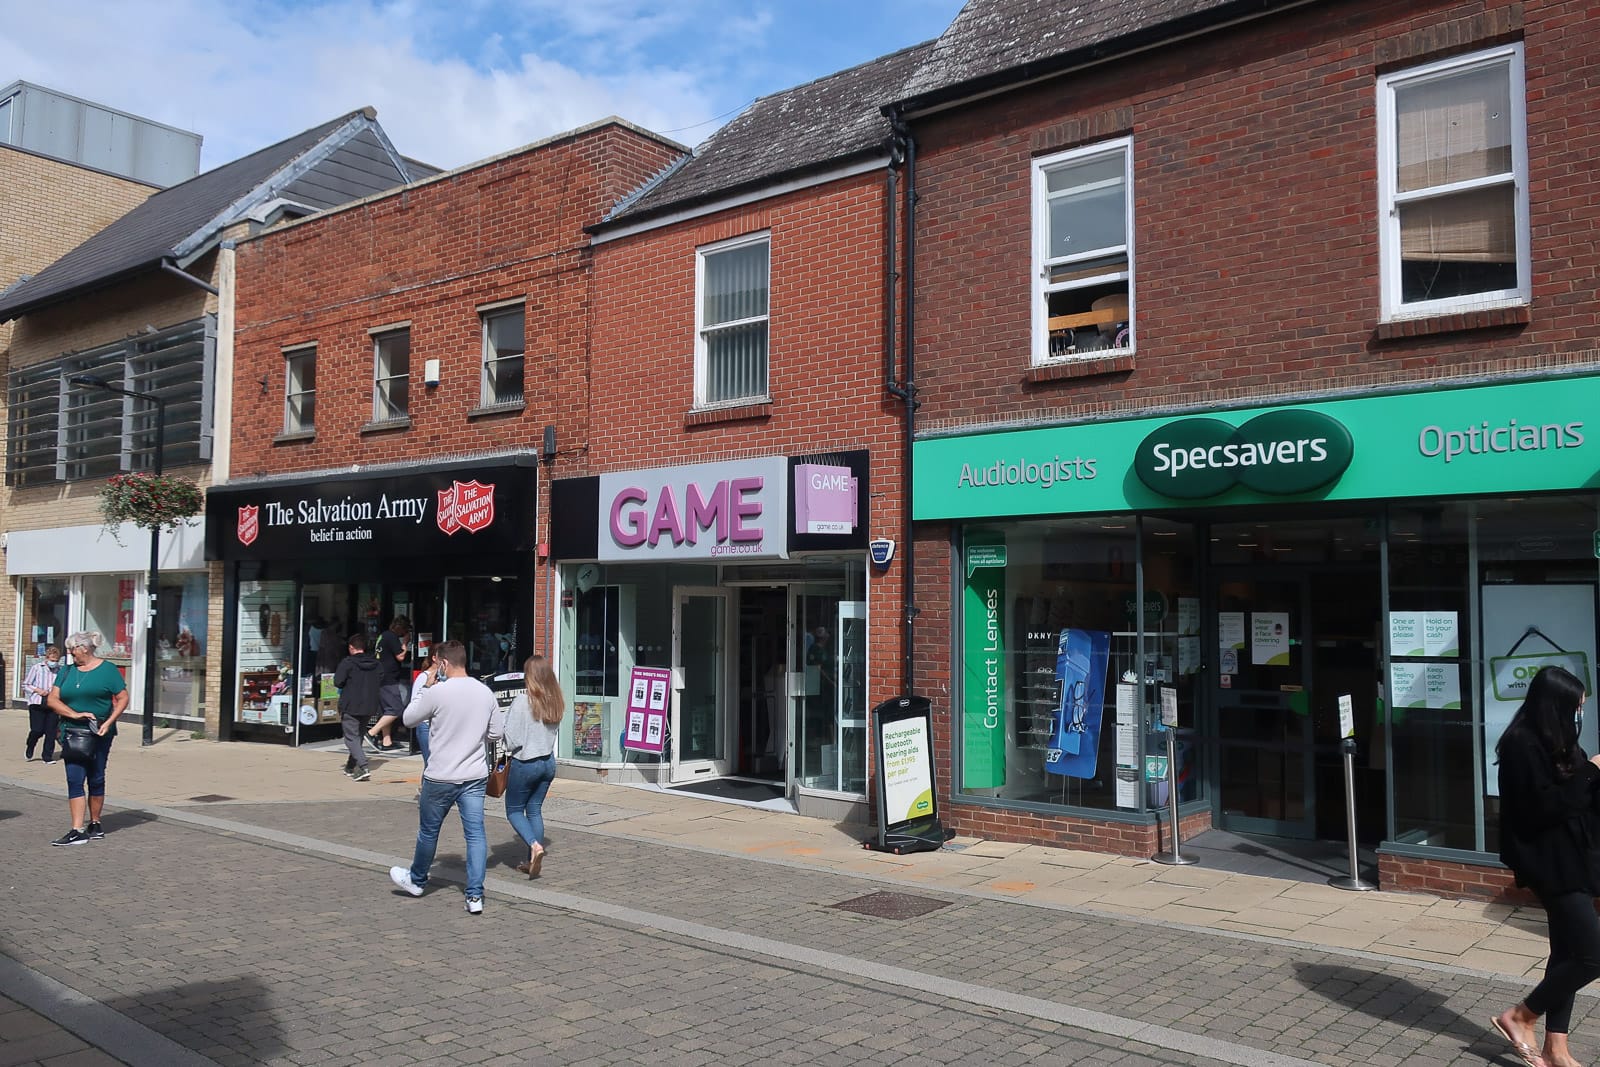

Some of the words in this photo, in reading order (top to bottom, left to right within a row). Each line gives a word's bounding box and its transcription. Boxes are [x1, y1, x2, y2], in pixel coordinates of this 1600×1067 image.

[1418, 418, 1585, 463] Opticians
[1153, 437, 1327, 477] Specsavers
[958, 455, 1098, 488] Audiologists
[811, 473, 849, 491] GAME
[464, 488, 477, 500] THE
[266, 502, 293, 527] The
[298, 496, 372, 524] Salvation
[376, 493, 428, 524] Army
[456, 492, 491, 517] SALVATION
[609, 476, 764, 547] GAME
[468, 506, 489, 525] ARMY
[310, 528, 335, 543] belief
[335, 528, 345, 541] in
[346, 526, 372, 541] action
[816, 523, 844, 531] game.co.uk
[711, 541, 763, 558] game.co.uk
[1125, 600, 1161, 615] Speavers
[984, 589, 998, 652] Lenses
[1028, 632, 1052, 640] DKNY
[984, 658, 998, 729] Contact
[1508, 681, 1527, 689] with
[885, 728, 921, 740] Rechargeable
[885, 738, 912, 750] Bluetooth
[886, 749, 907, 759] hearing
